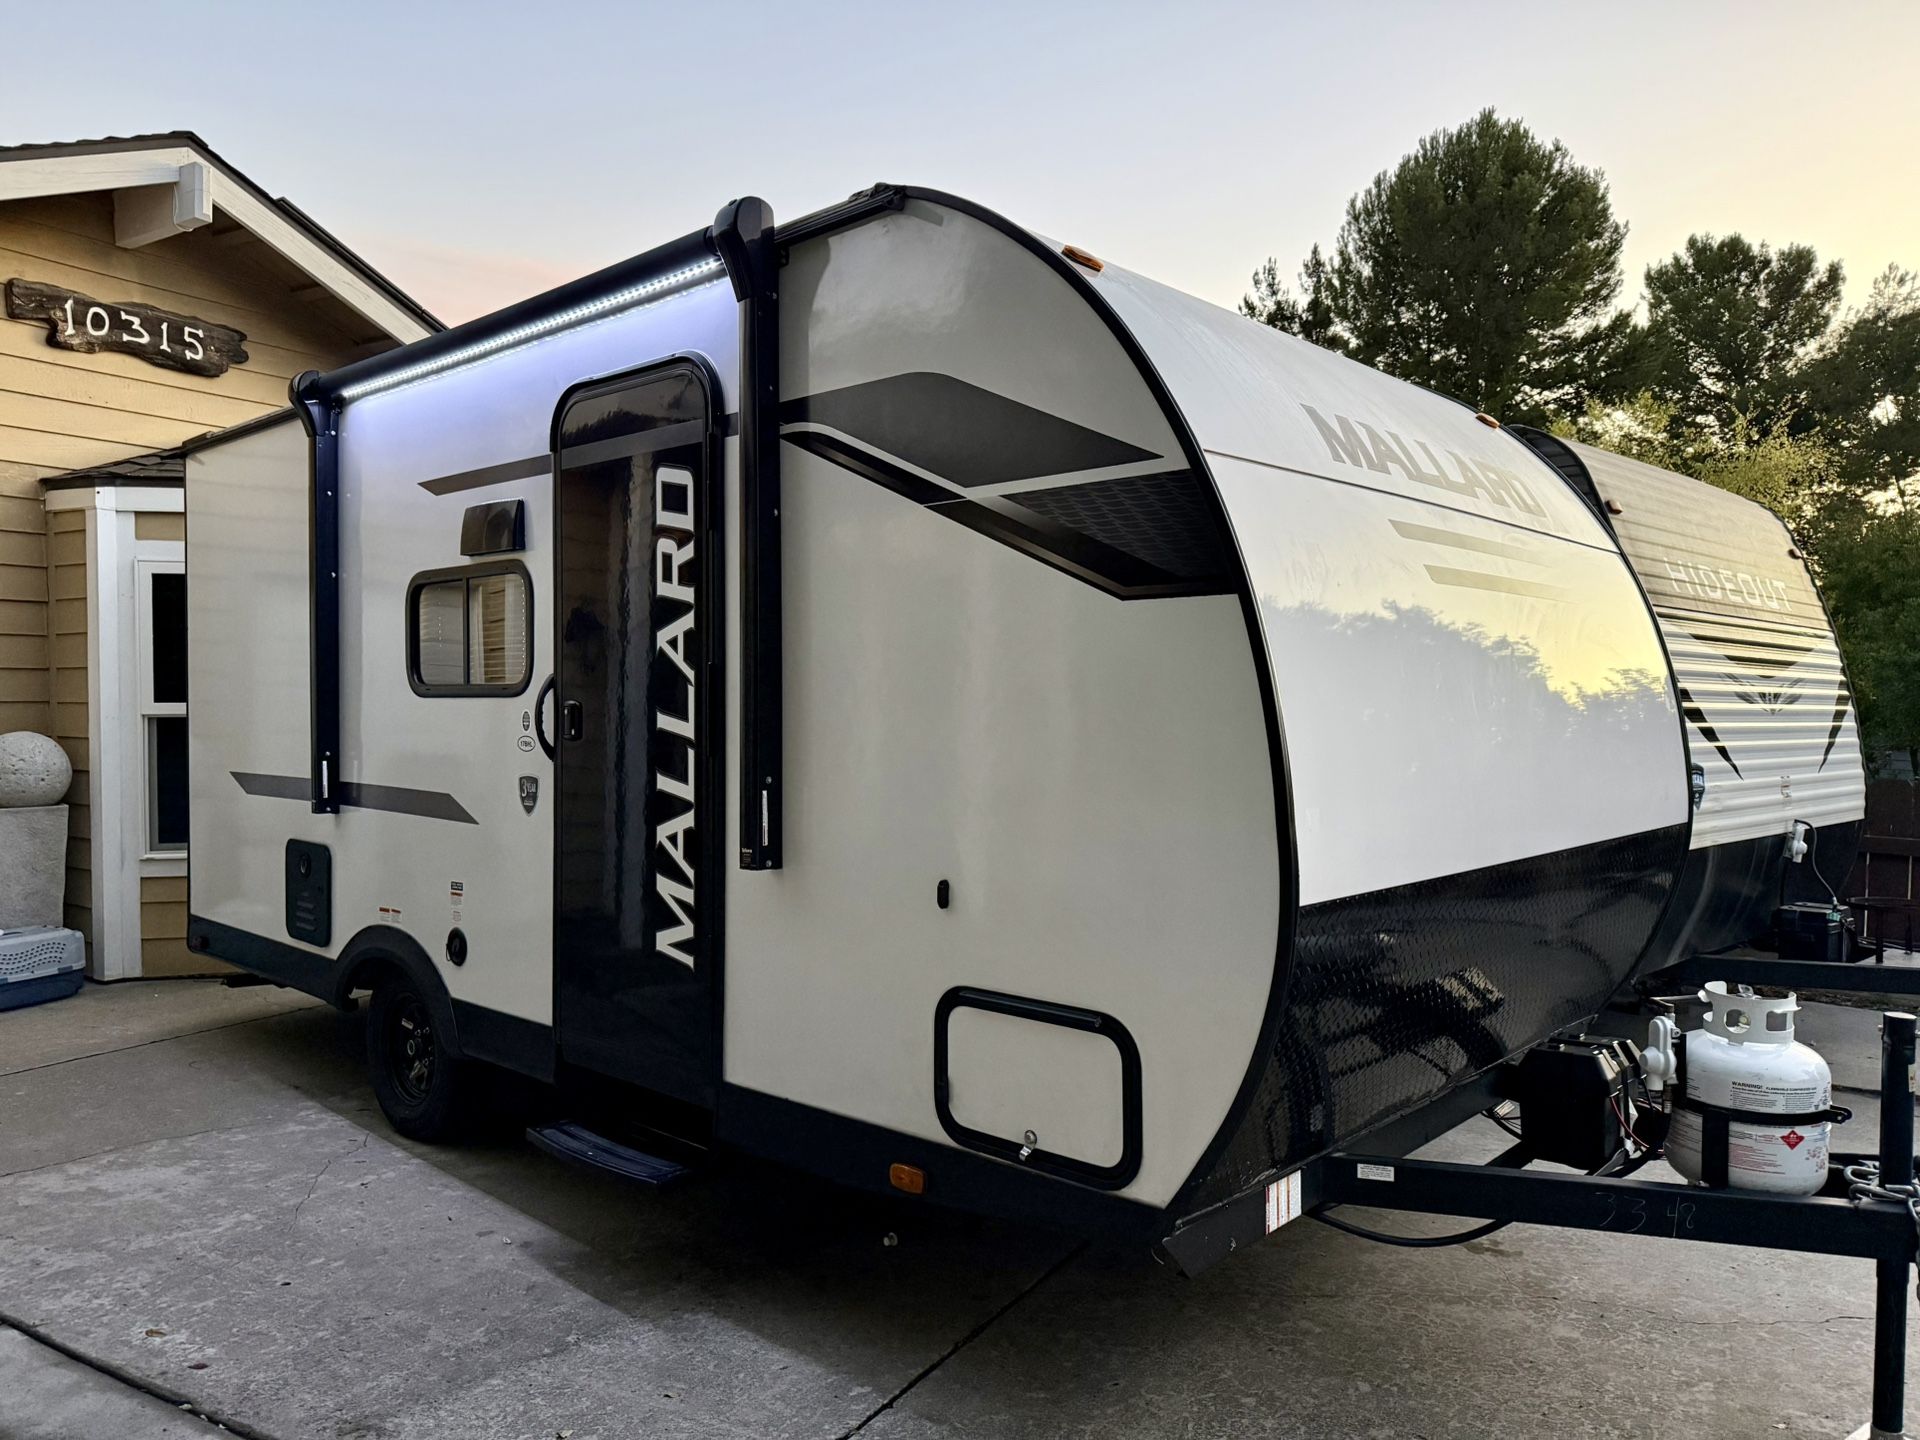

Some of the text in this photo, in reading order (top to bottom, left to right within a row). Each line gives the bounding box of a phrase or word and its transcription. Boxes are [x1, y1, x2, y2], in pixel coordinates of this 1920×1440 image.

[64, 299, 204, 360] 10315
[1300, 403, 1547, 518] MALLARD
[1663, 557, 1792, 611] HIDEOUT
[655, 465, 695, 973] MALLARD
